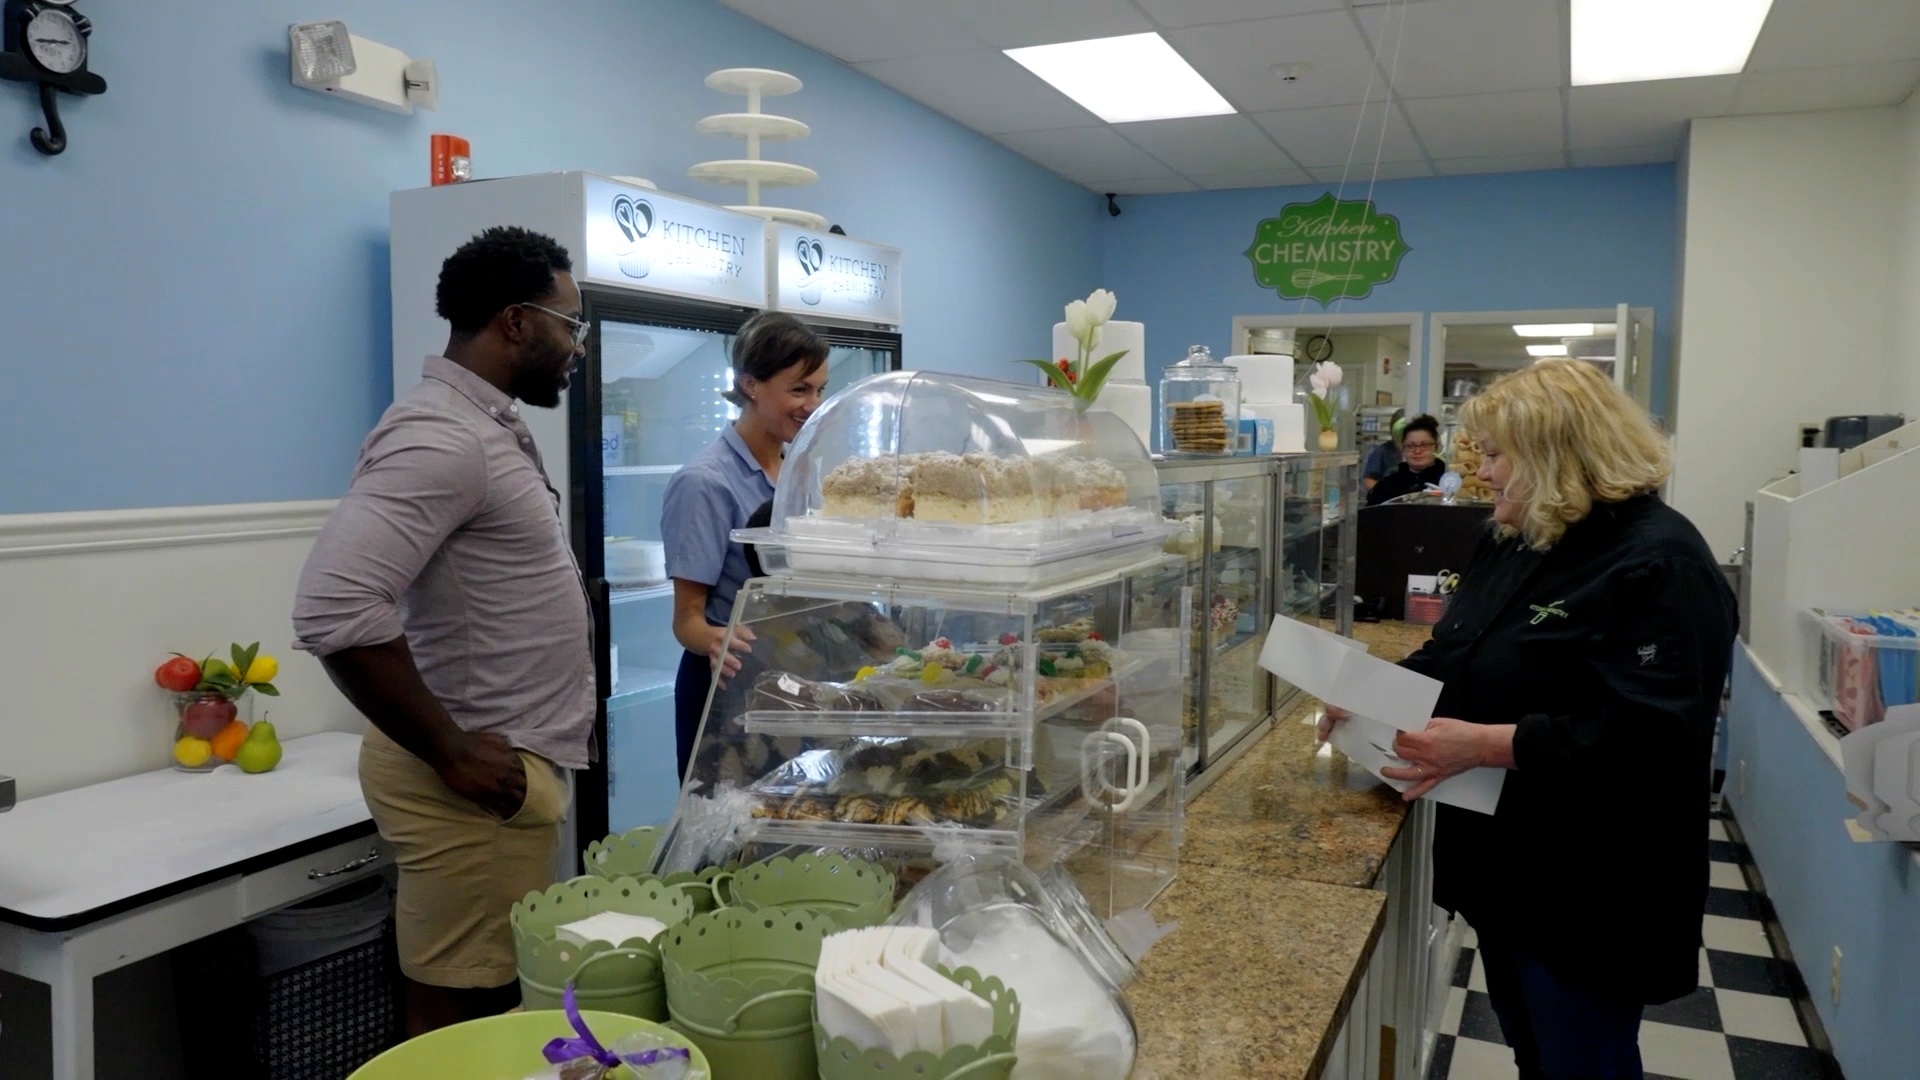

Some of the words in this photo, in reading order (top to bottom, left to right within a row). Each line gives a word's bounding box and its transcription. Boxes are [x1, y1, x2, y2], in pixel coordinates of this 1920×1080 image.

[662, 219, 745, 257] KITCHEN
[1277, 215, 1379, 238] Kitchen
[666, 252, 743, 278] CHEMISTRY
[1254, 239, 1396, 265] CHEMISTRY
[829, 255, 888, 281] KITCHEN
